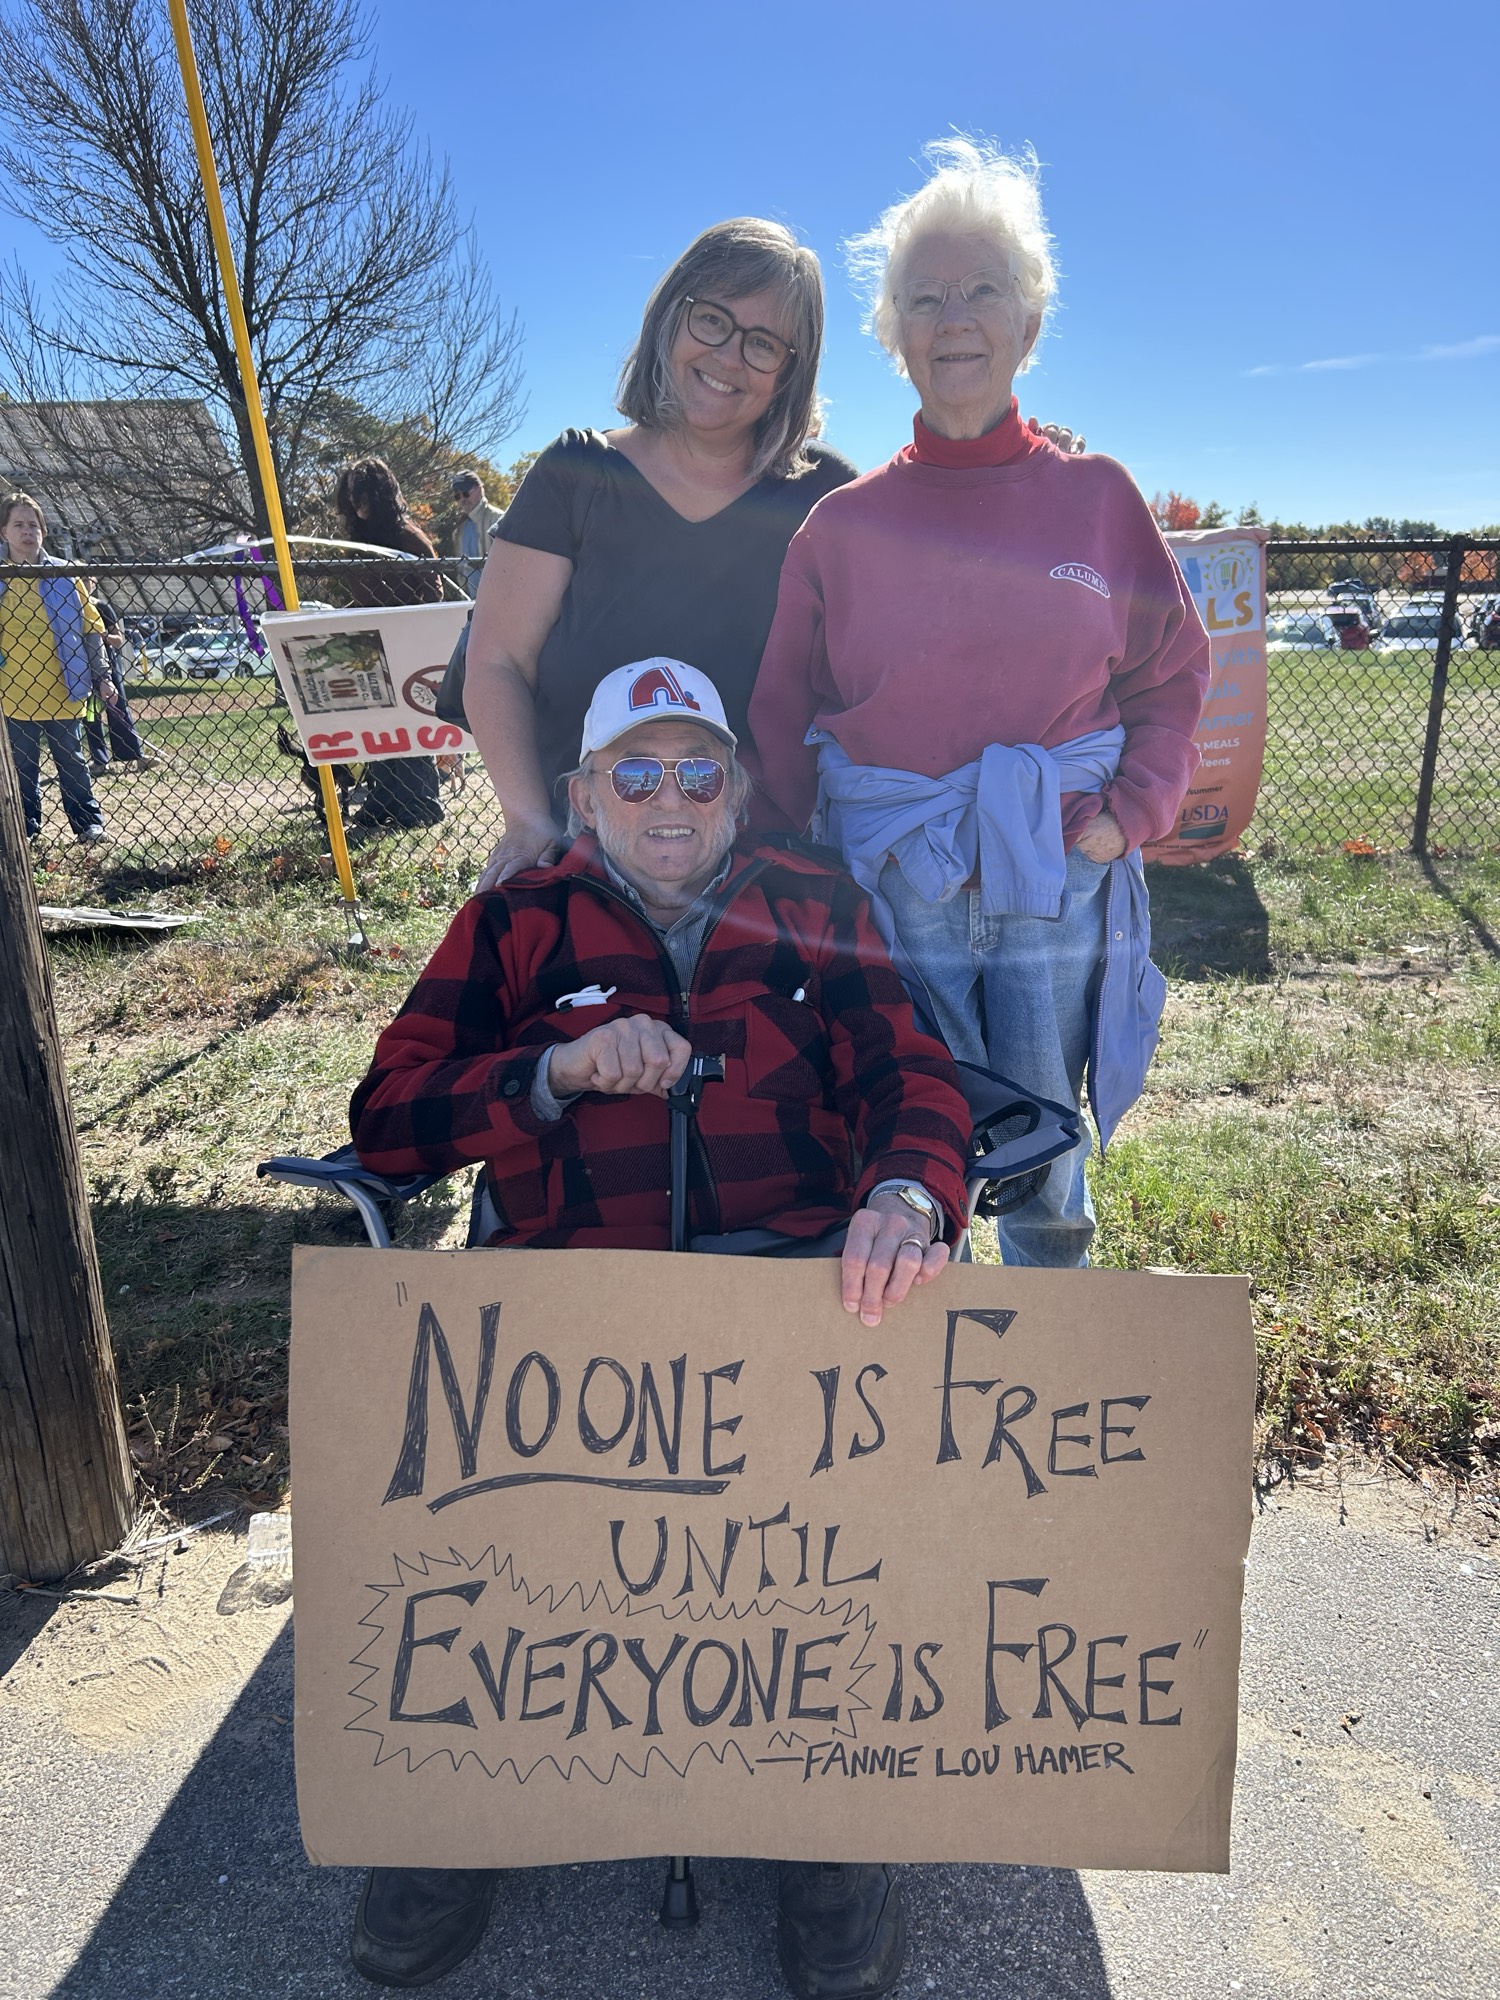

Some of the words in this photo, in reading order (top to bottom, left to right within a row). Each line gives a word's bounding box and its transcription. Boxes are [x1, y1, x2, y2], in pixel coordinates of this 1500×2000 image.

[327, 678, 359, 698] NO
[1203, 738, 1240, 751] MEALS
[1181, 804, 1229, 822] USDA
[934, 1309, 1153, 1500] FREE
[609, 1501, 883, 1600] UNTIL
[390, 1580, 851, 1741] EVERYONE
[935, 1744, 1001, 1778] LOU
[1015, 1741, 1135, 1776] HAMER
